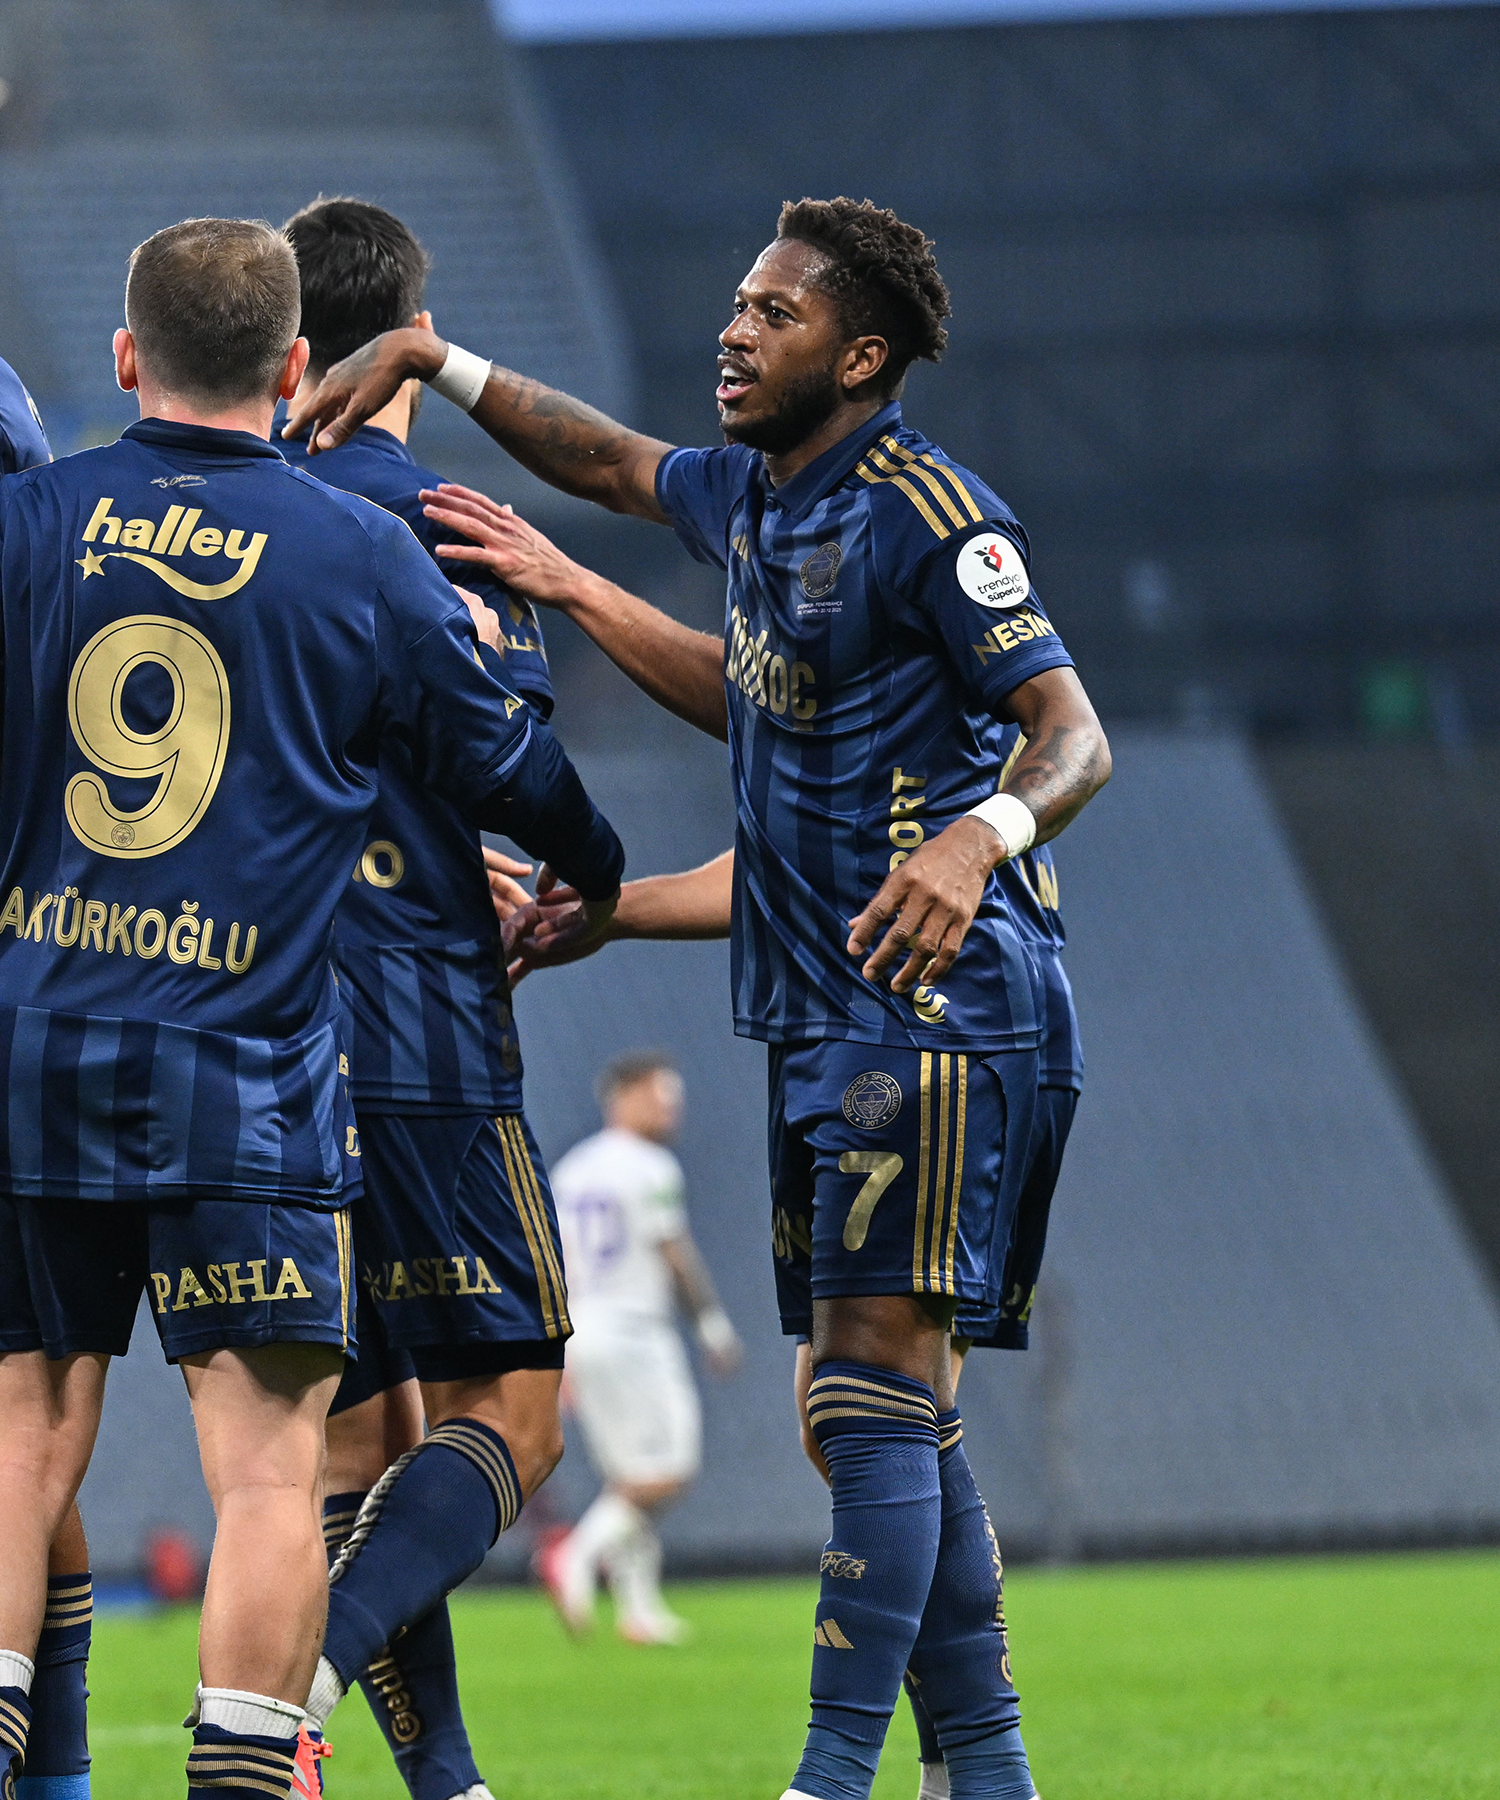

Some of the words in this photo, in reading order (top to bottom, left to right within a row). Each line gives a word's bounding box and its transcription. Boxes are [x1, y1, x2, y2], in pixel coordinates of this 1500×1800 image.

[75, 497, 270, 601] halley
[63, 613, 232, 860] 9
[838, 1150, 904, 1252] 7
[150, 1256, 313, 1314] PASHA
